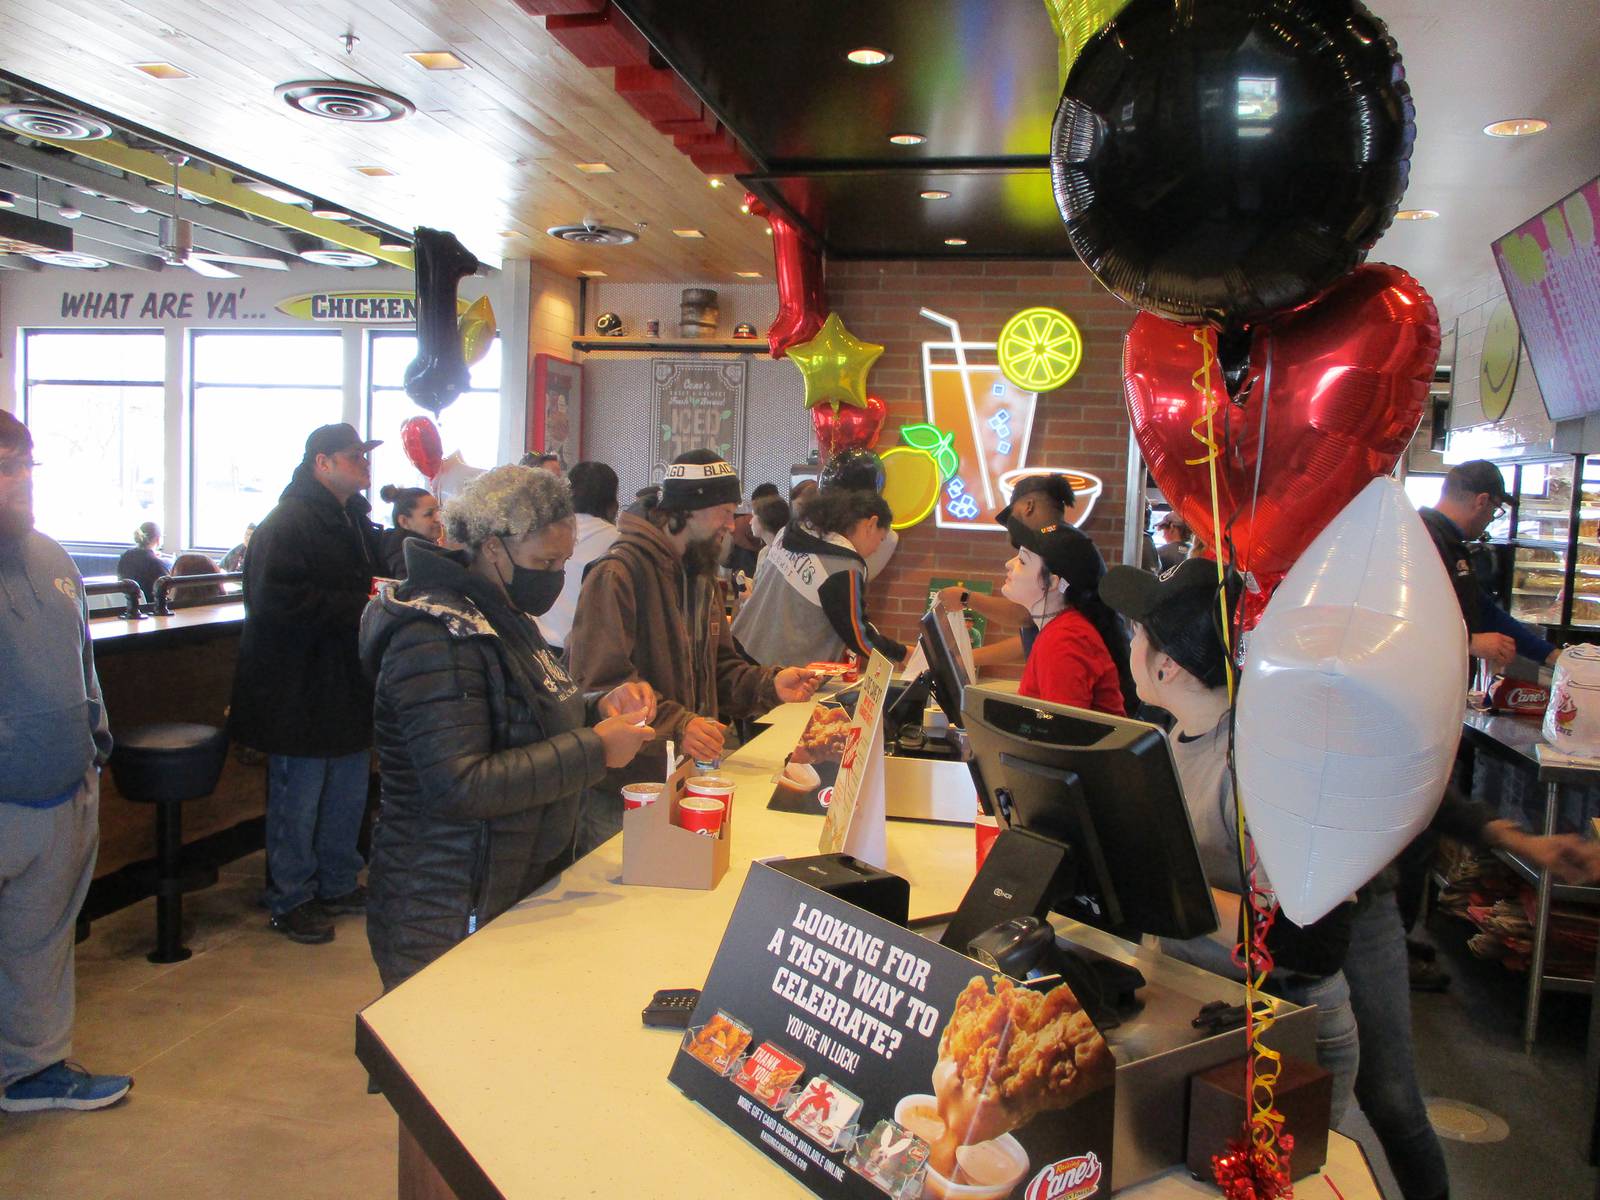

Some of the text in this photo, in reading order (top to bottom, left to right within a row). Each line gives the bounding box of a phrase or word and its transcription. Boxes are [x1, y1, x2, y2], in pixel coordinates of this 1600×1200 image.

[61, 291, 134, 319] WHAT
[140, 291, 194, 319] ARE
[311, 294, 417, 320] CHICKEN
[671, 408, 721, 434] ICED
[1506, 687, 1546, 706] Cane's
[792, 902, 932, 992] LOOKING FOR
[767, 927, 940, 1038] A TASTY WAY TO
[771, 966, 903, 1060] CELEBRATE?
[751, 1046, 782, 1072] THANK
[785, 1014, 821, 1049] YOU'RE
[817, 1033, 831, 1057] IN
[829, 1040, 861, 1074] LUCK!
[737, 1095, 753, 1113] MORE
[750, 1105, 764, 1121] GIFT
[762, 1113, 778, 1131] CARD
[775, 1122, 799, 1148] DESIGNS
[796, 1139, 826, 1167] AVAILABLE
[823, 1156, 846, 1183] ONLINE
[1027, 1151, 1099, 1200] Cane's
